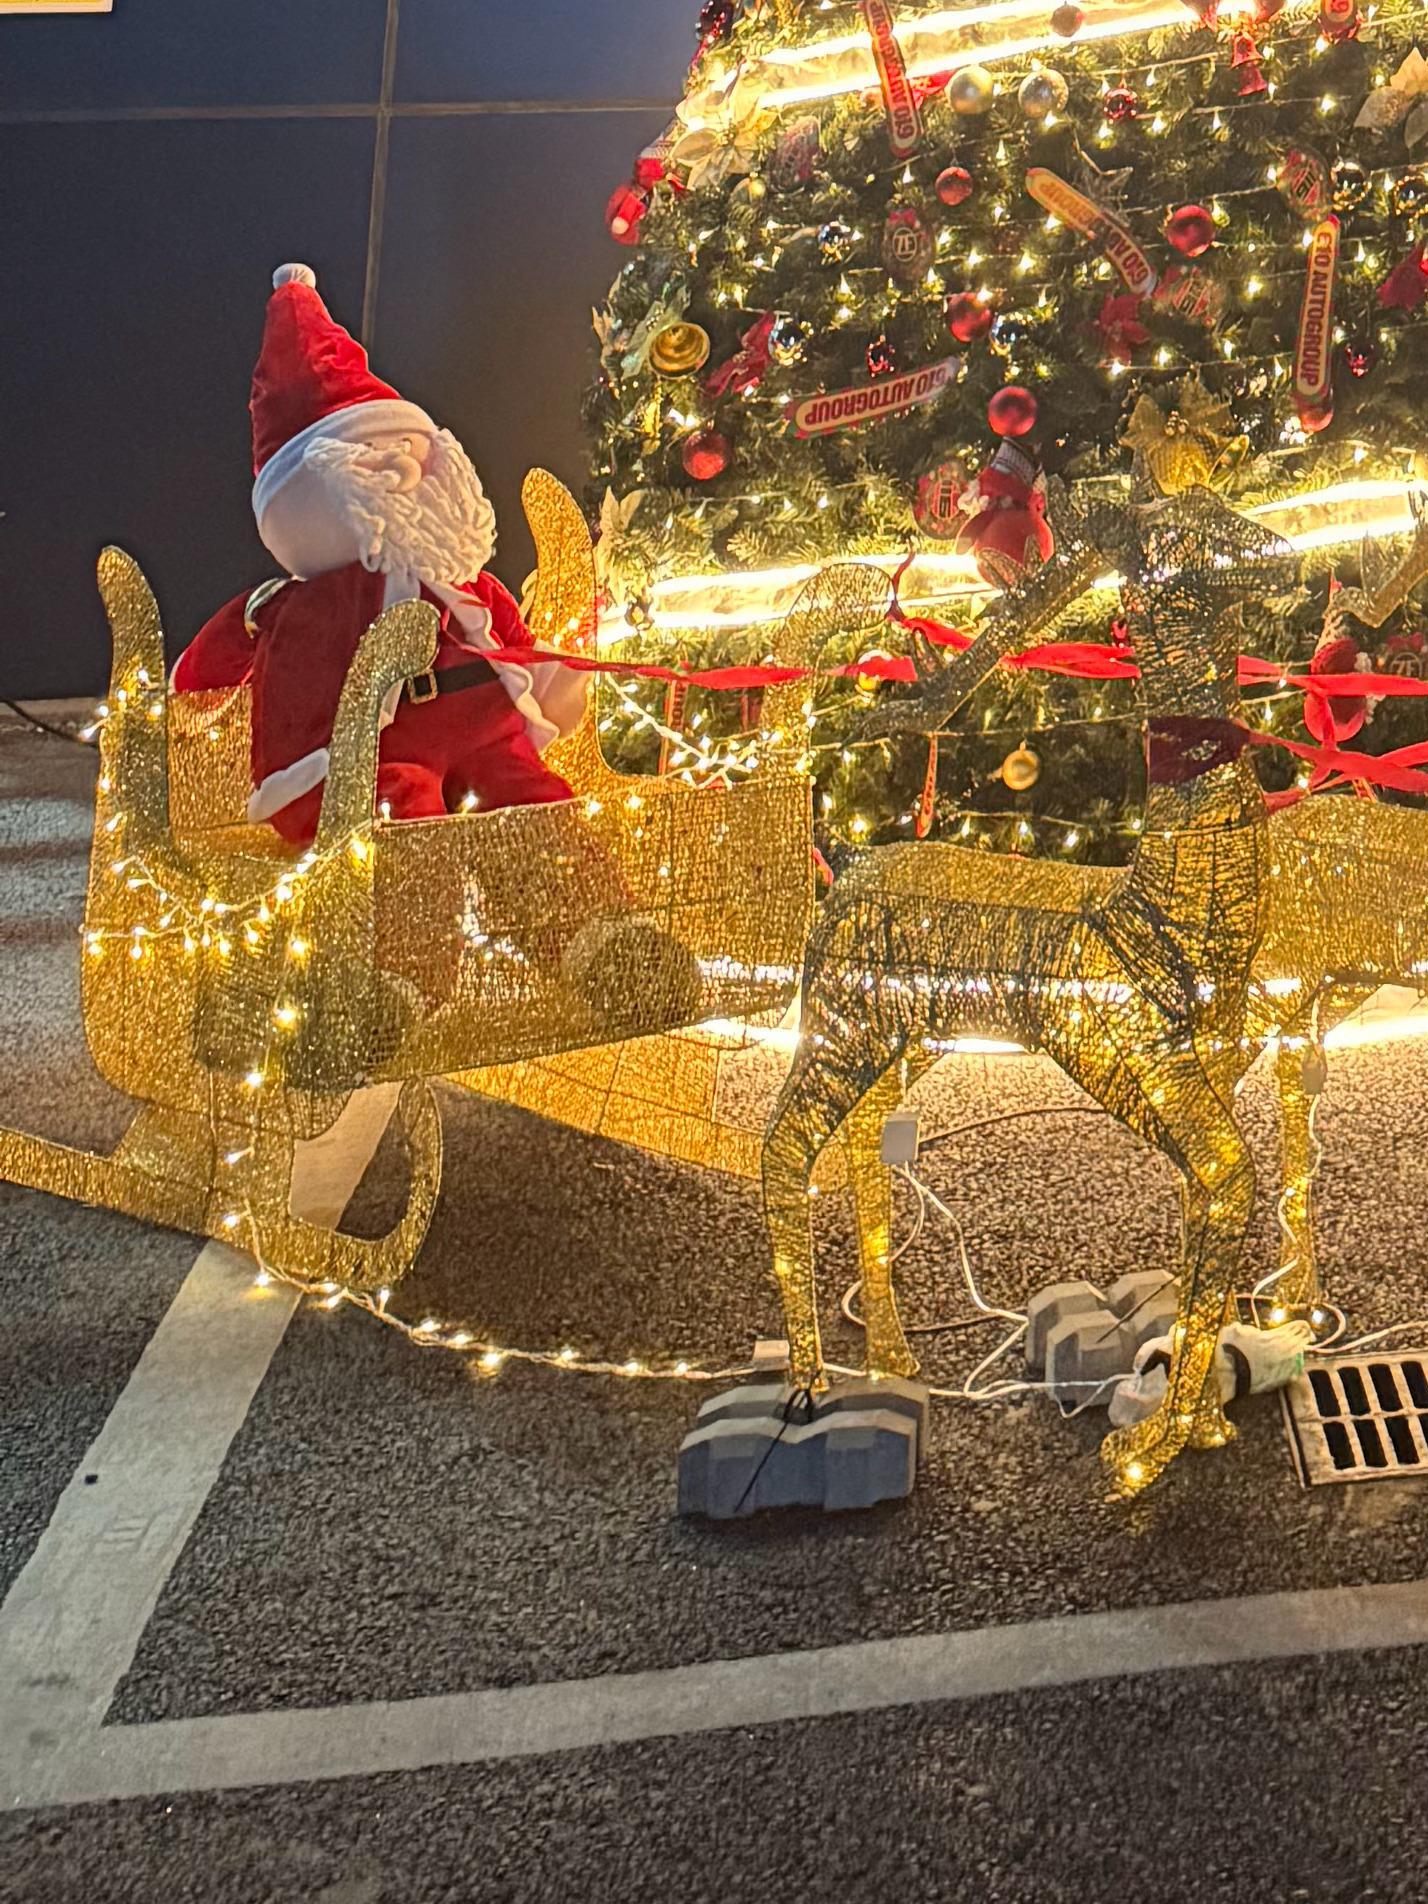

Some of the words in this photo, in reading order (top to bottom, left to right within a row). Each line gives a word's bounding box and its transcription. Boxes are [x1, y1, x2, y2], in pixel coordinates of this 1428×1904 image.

[894, 106, 915, 139] 610
[1314, 231, 1333, 267] 610
[1122, 254, 1149, 285] 610
[1300, 270, 1329, 386] AUTOGROUP
[916, 367, 946, 397] 610
[804, 378, 916, 425] AUTOGROUP
